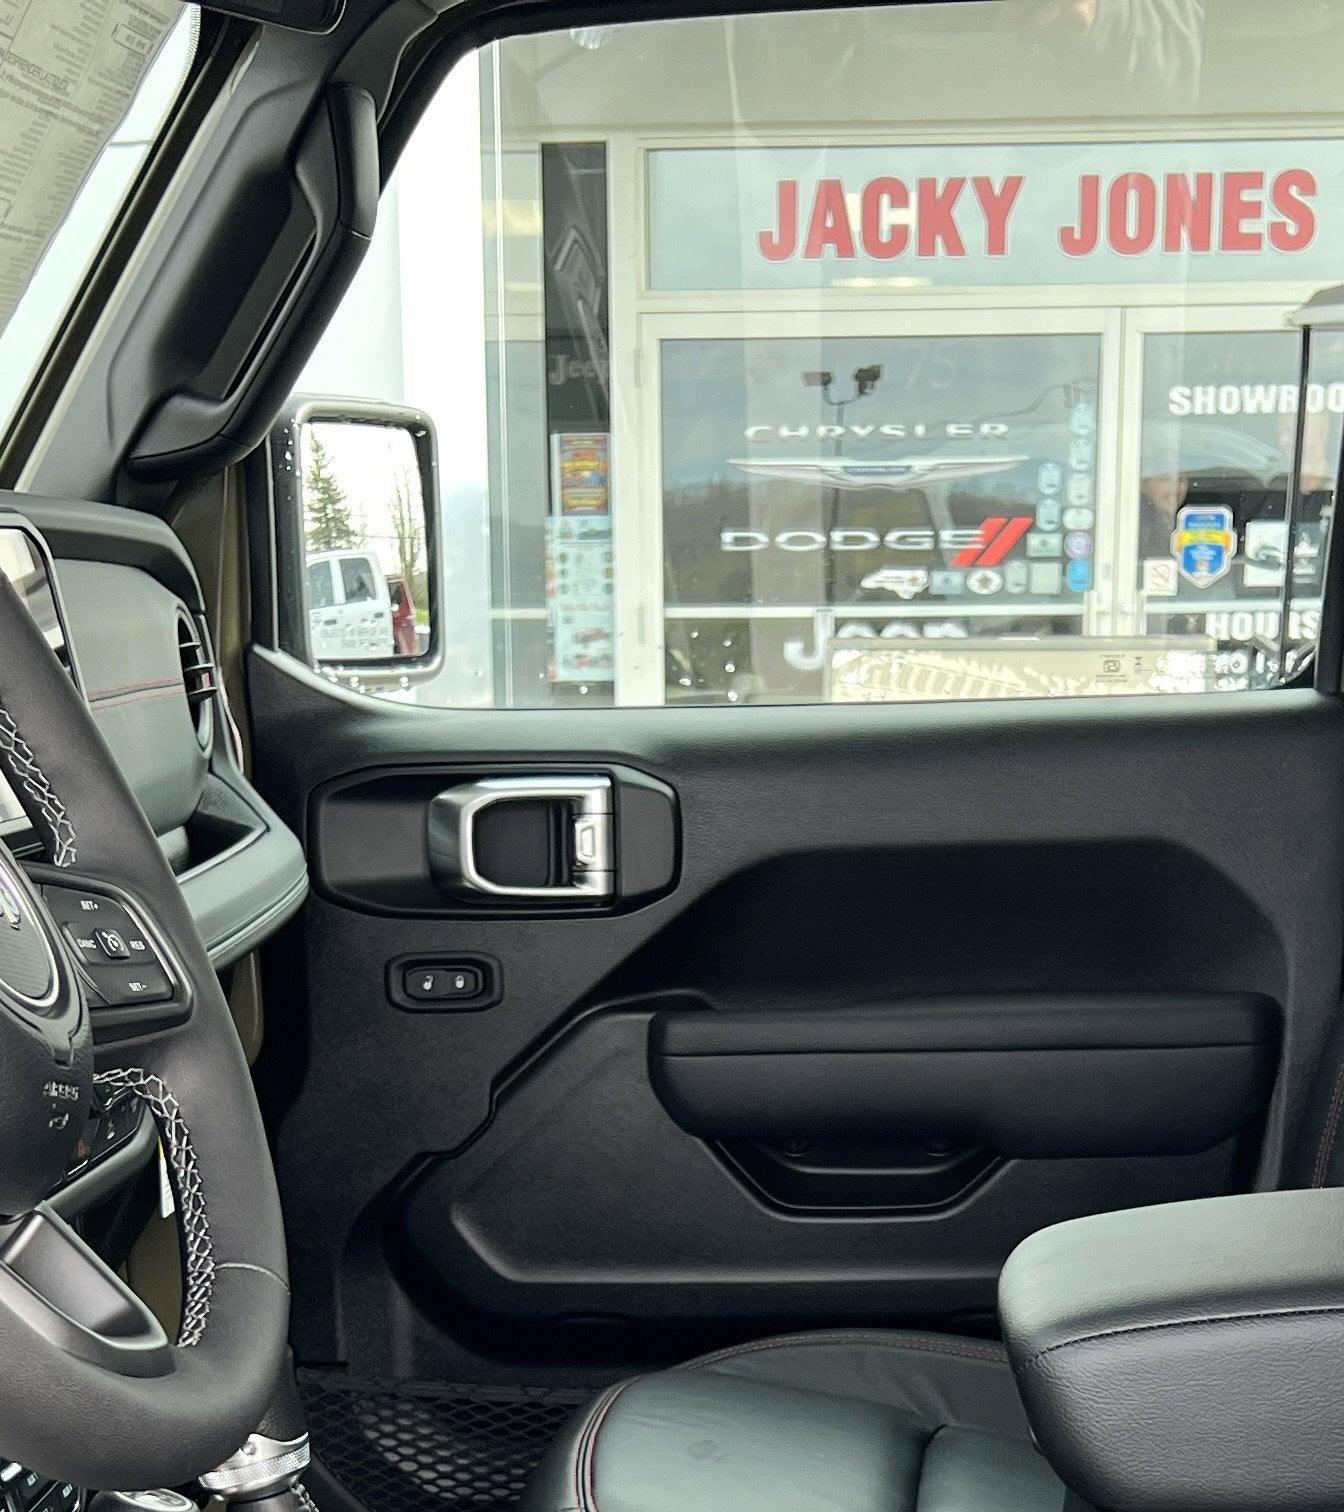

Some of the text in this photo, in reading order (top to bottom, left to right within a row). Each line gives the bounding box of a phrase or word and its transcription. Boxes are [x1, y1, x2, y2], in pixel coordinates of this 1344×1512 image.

[757, 168, 1319, 263] JACKY JONES
[744, 422, 1011, 442] CHRYSLER
[719, 529, 987, 552] DODGE
